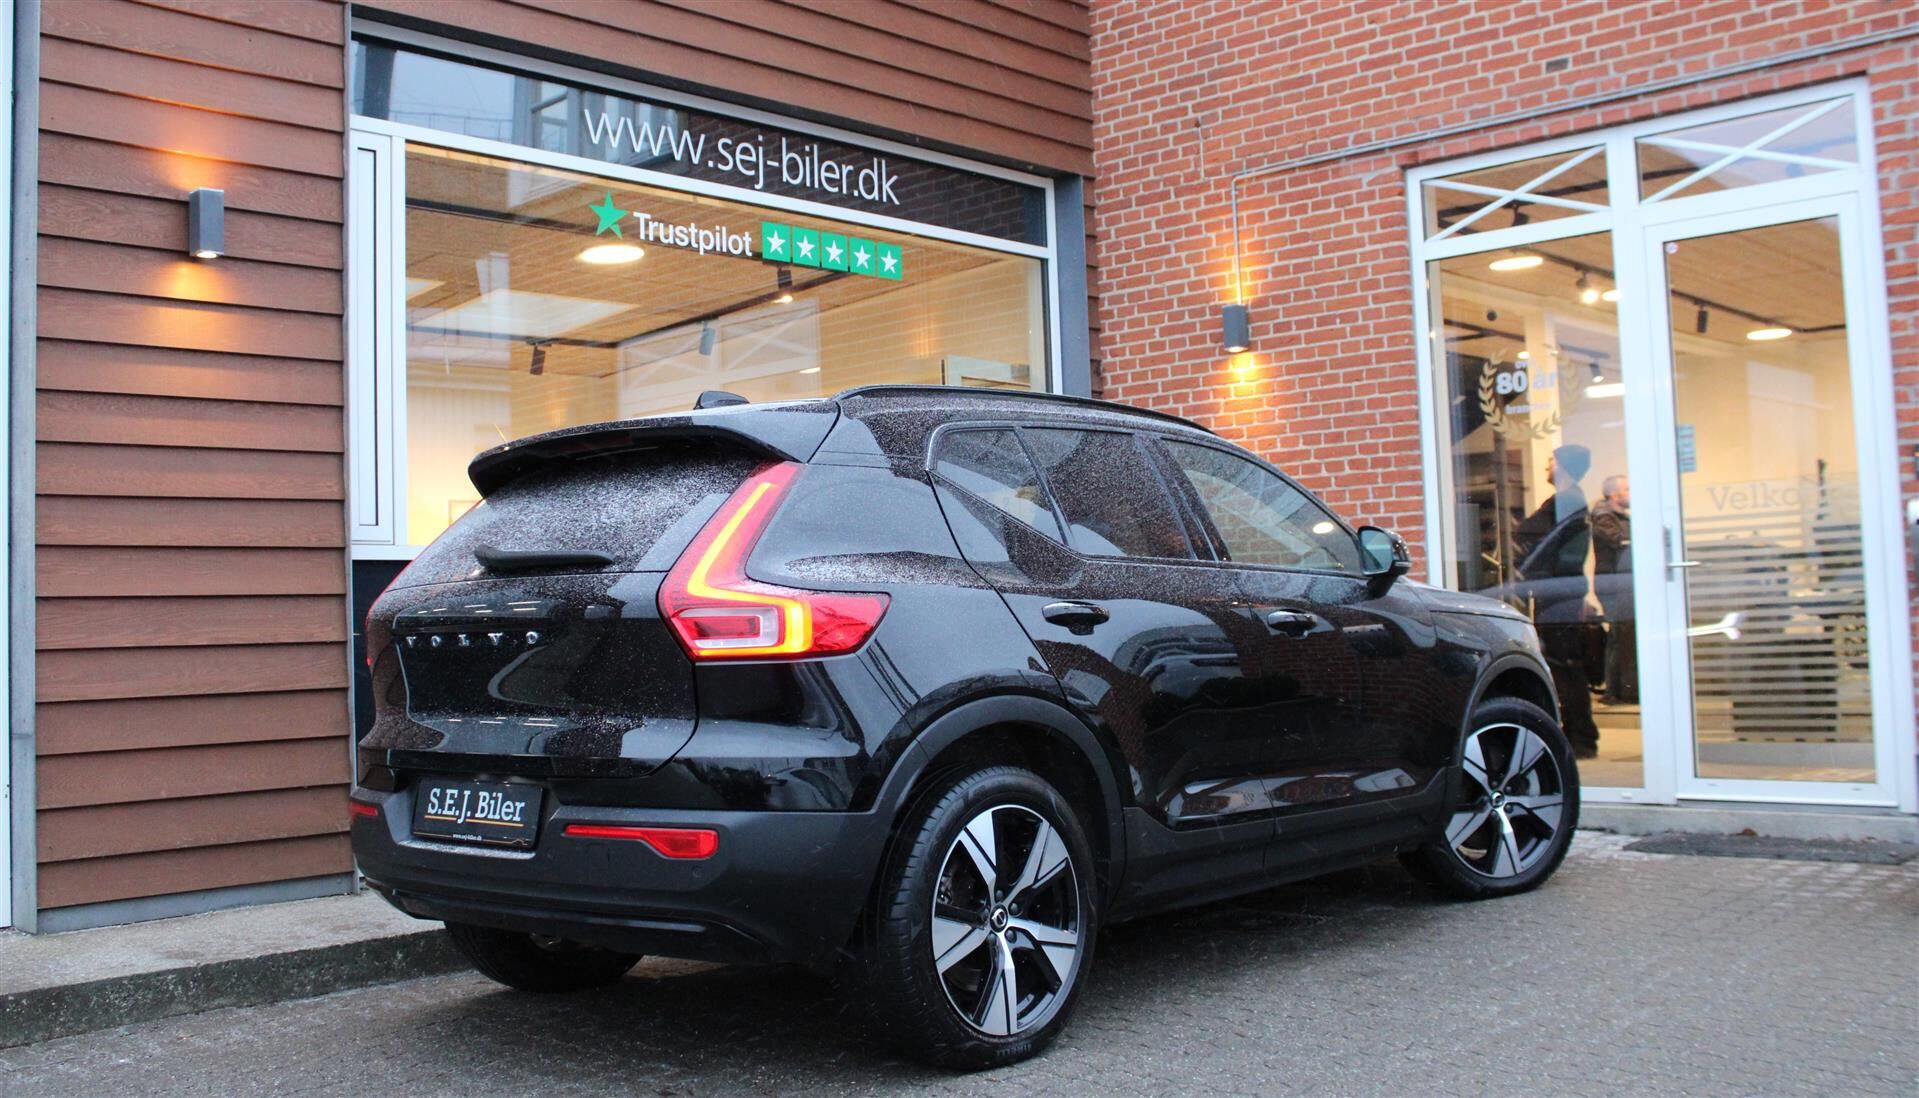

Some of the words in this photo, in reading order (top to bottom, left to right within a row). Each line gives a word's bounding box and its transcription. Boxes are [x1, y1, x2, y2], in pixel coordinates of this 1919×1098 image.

[584, 108, 900, 205] www.sej-biler.dk
[633, 211, 753, 257] Trustpilot
[1496, 370, 1528, 395] 80
[405, 631, 539, 649] VOLVO
[427, 787, 471, 824] S.E.J.
[475, 791, 526, 823] Biler
